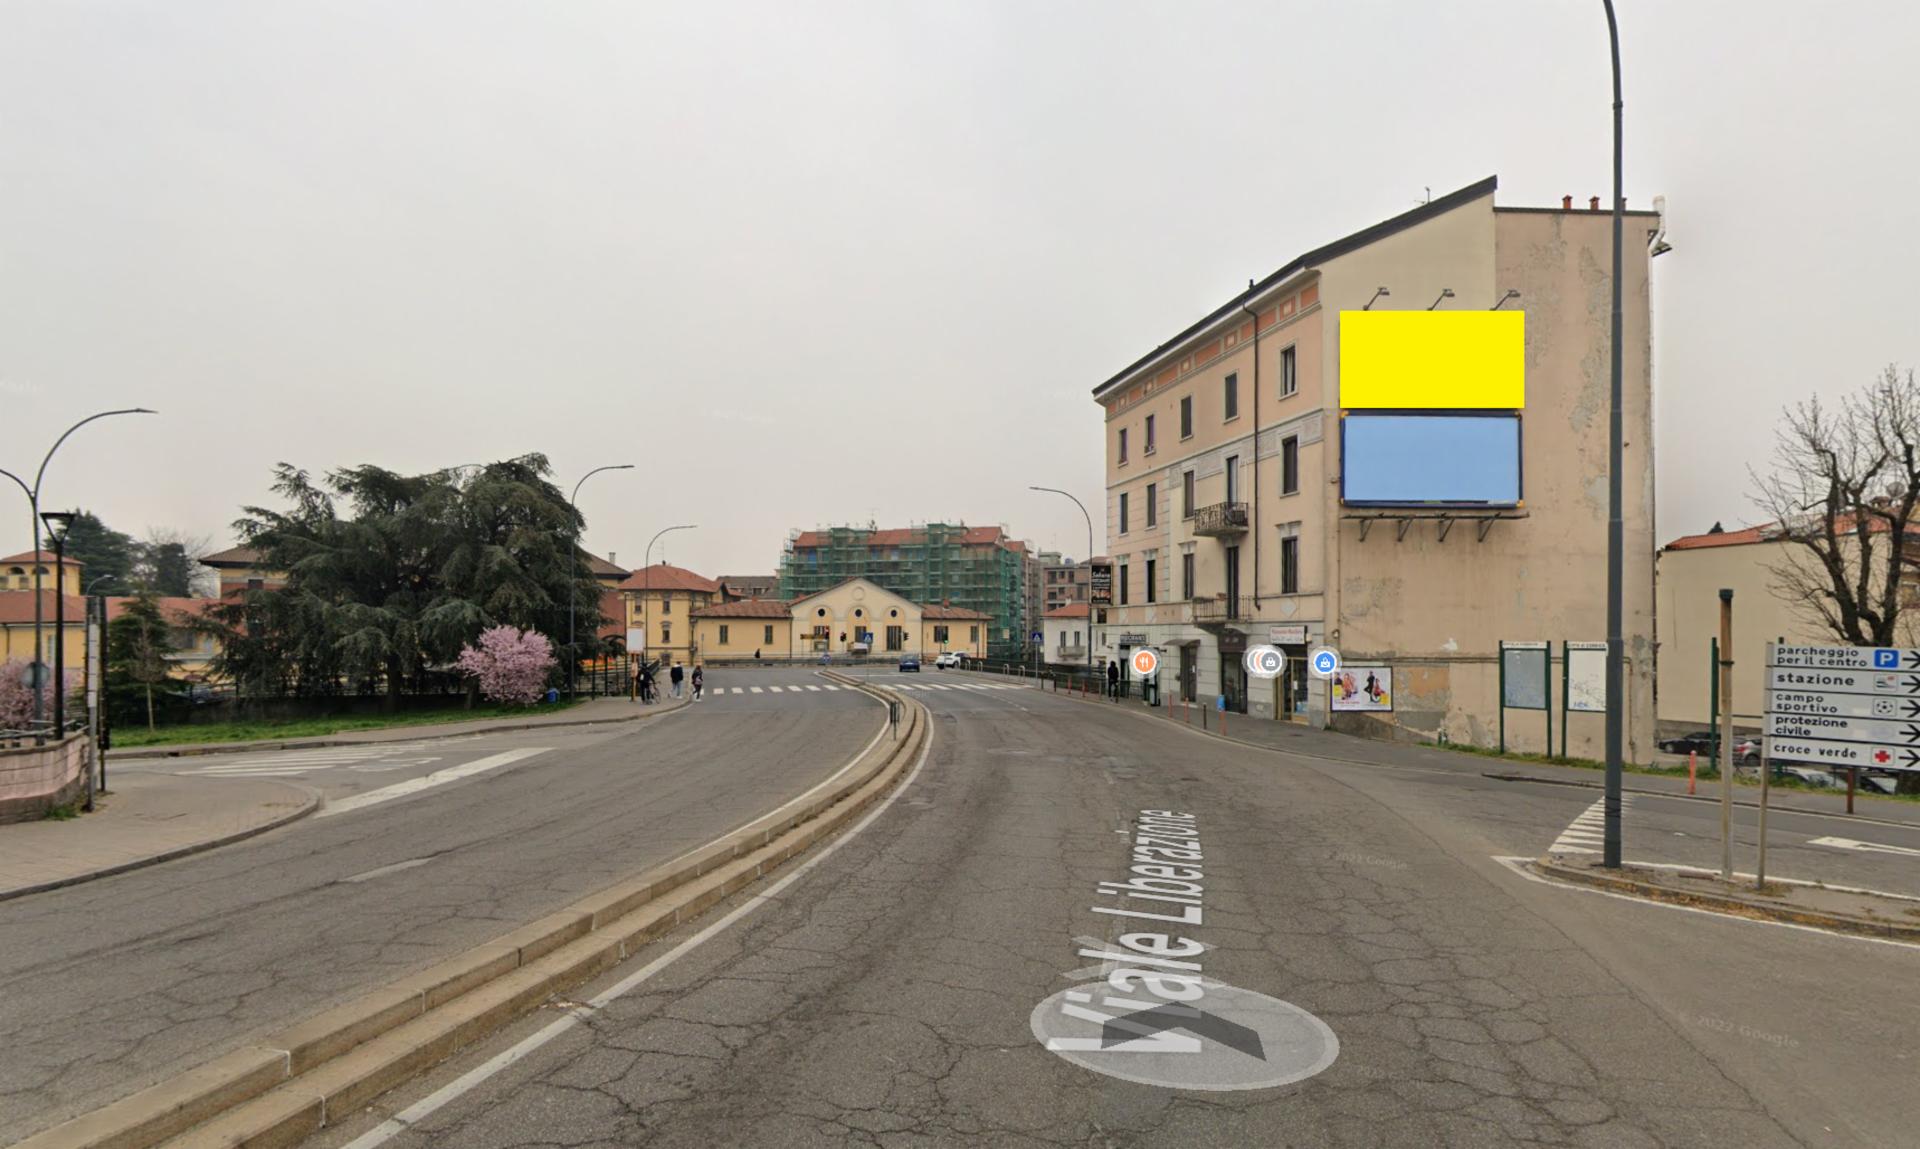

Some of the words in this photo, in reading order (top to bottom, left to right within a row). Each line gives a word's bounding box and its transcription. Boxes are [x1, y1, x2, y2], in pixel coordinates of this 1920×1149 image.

[1777, 647, 1859, 657] parcheggio
[1777, 656, 1800, 664] per
[1805, 656, 1814, 665] il
[1819, 658, 1867, 667] centro
[1777, 672, 1854, 686] stazione
[1776, 693, 1824, 703] campo
[1776, 703, 1838, 713] sportivo
[1775, 716, 1848, 728] protezione
[1775, 726, 1811, 736] civile
[1774, 744, 1811, 754] croce
[1819, 748, 1857, 758] verde
